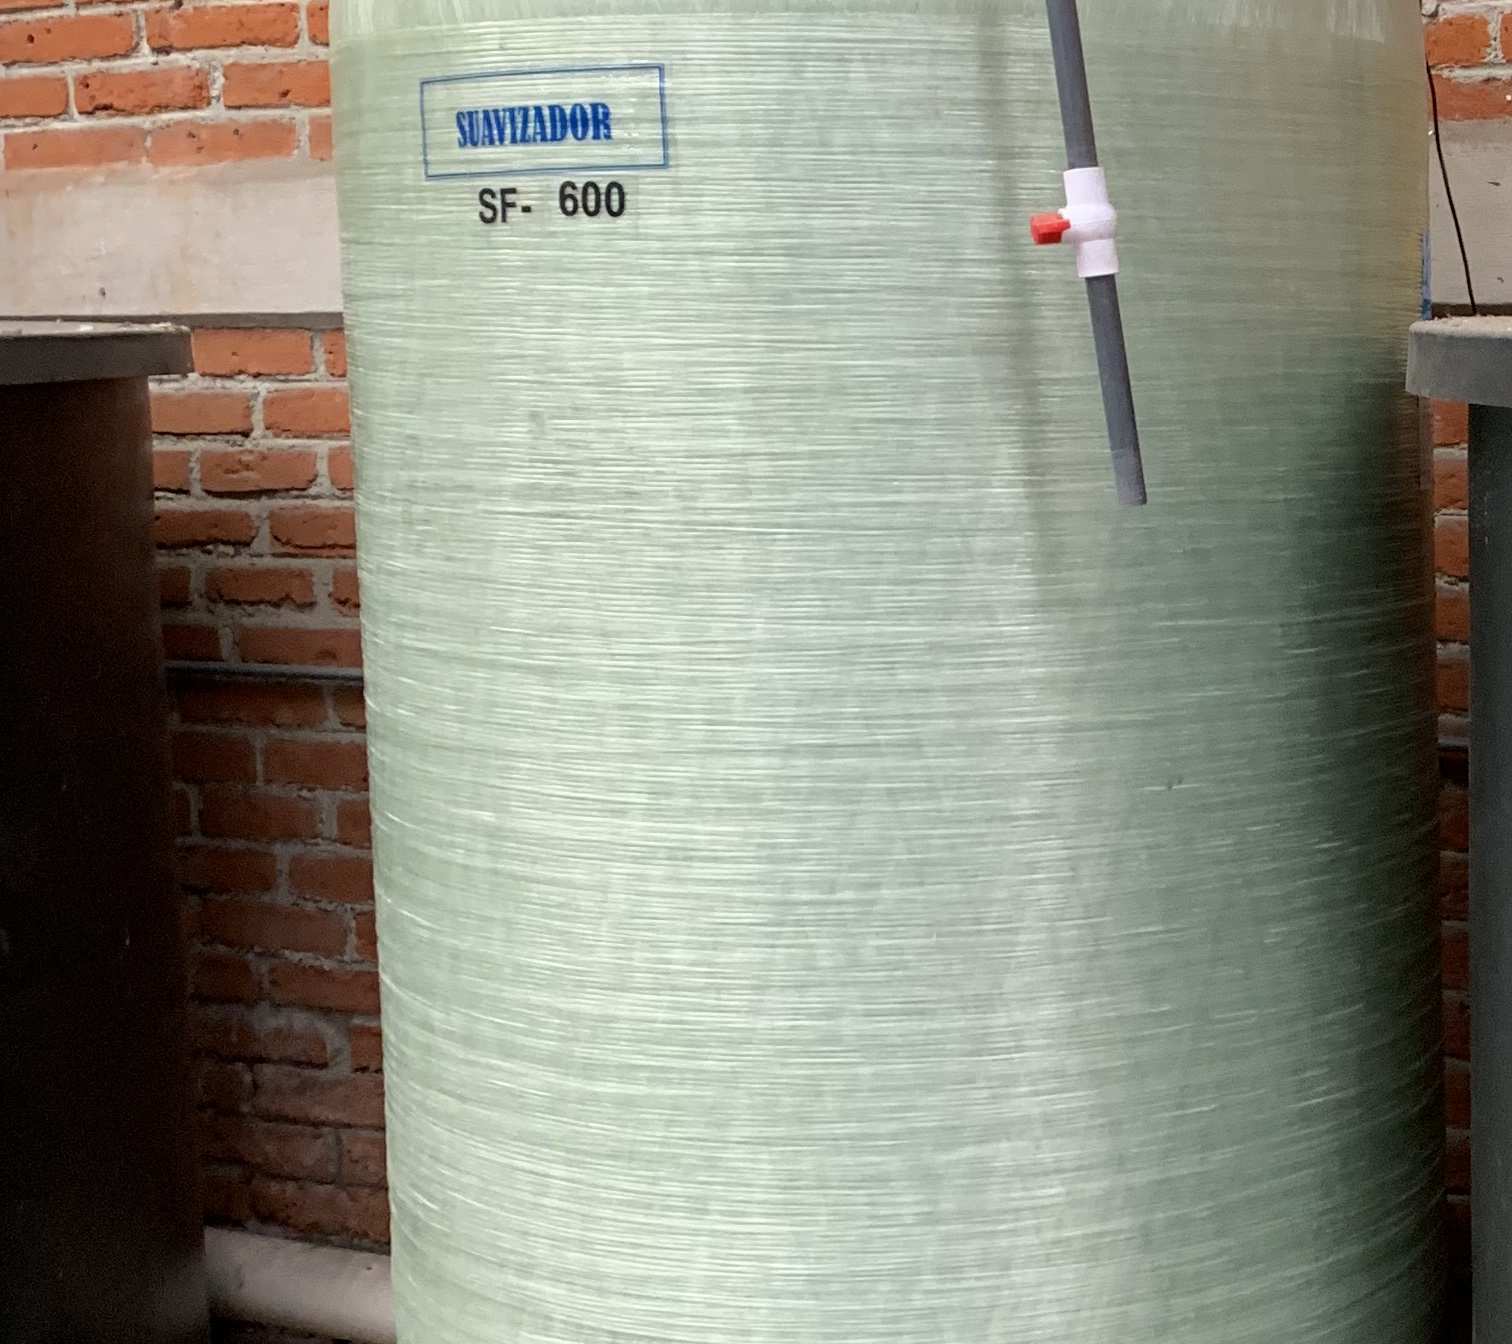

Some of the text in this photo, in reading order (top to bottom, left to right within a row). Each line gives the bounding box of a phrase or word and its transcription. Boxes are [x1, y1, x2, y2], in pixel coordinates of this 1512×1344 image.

[456, 102, 613, 148] SUAVIZADOR
[478, 181, 626, 224] SF- 600
